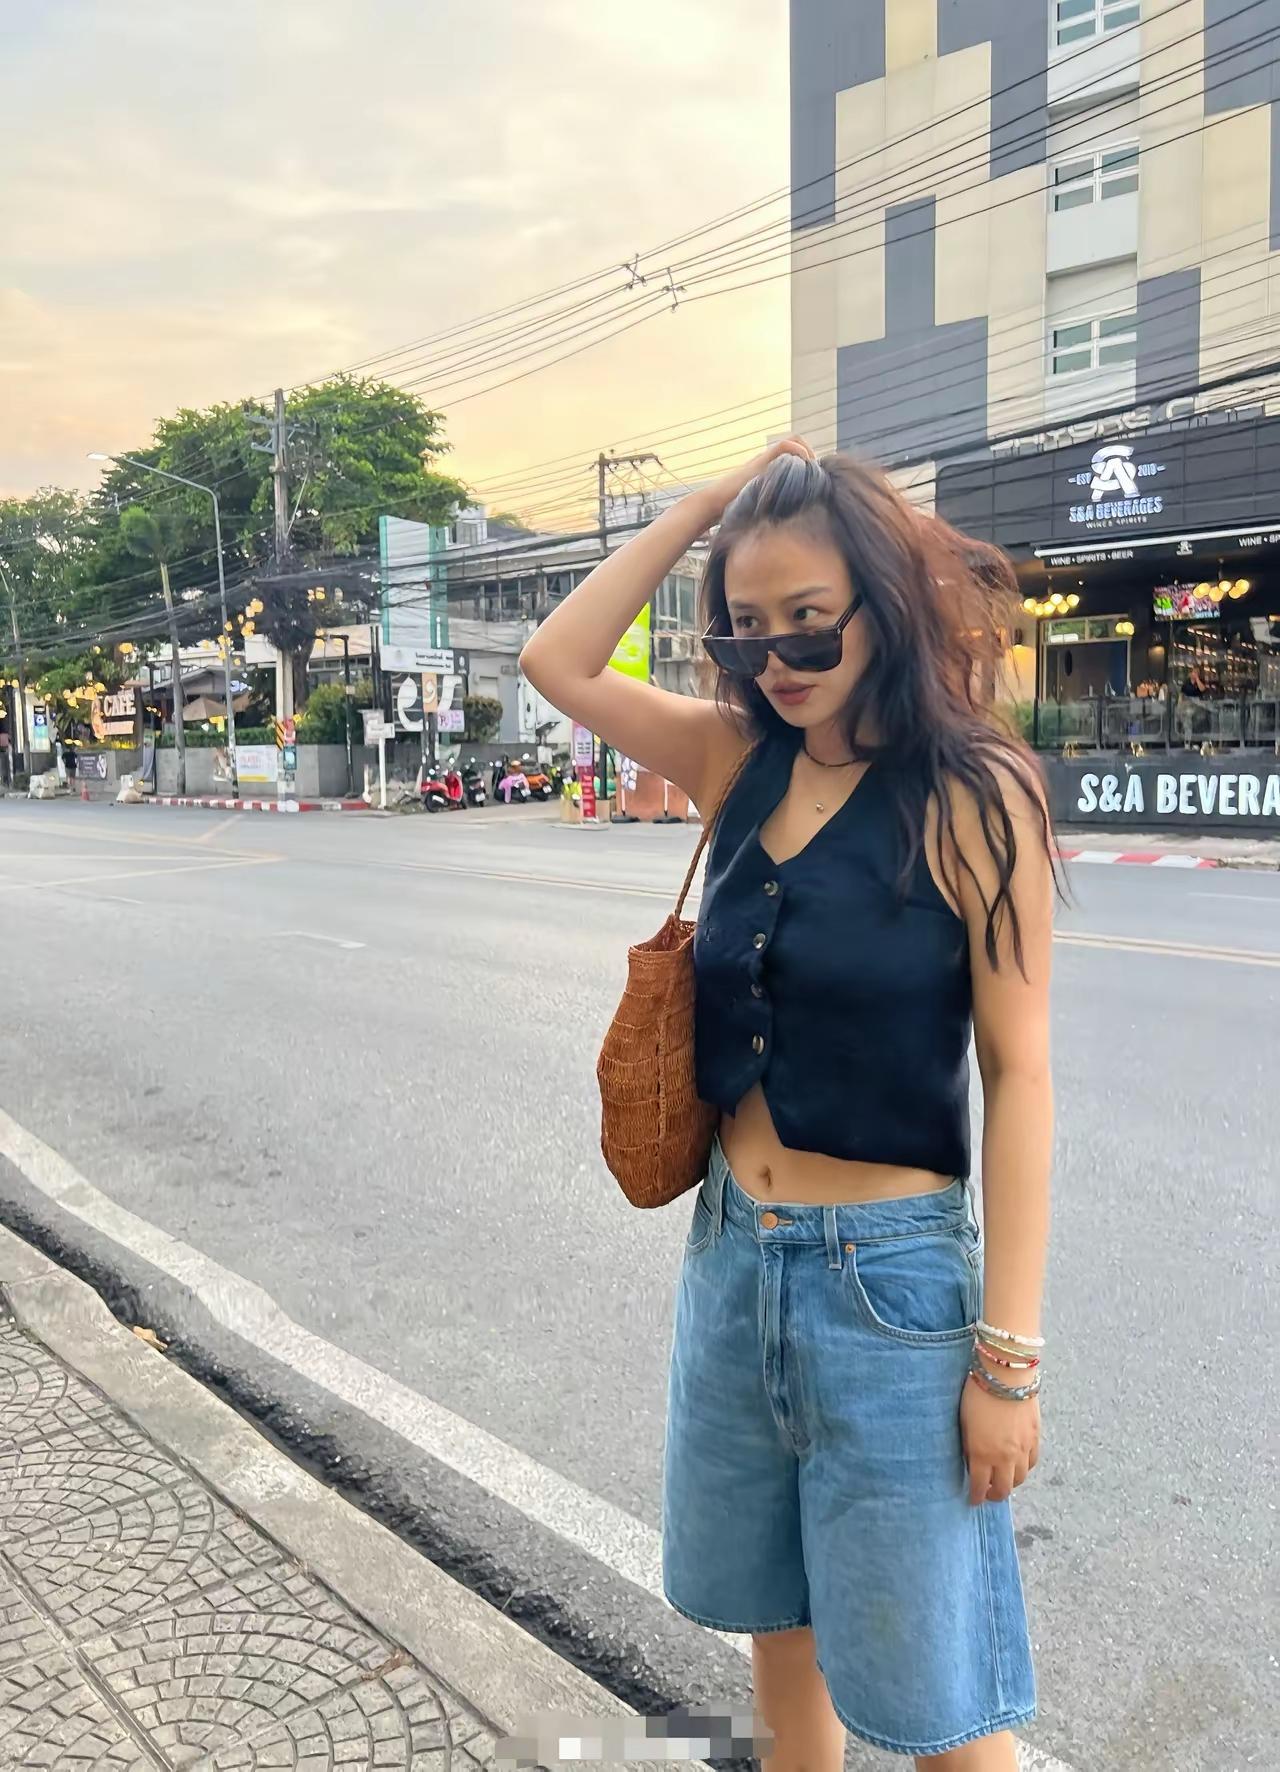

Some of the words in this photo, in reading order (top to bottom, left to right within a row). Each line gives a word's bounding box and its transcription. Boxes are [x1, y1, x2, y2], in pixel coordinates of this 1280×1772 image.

[1069, 504, 1094, 523] S&A
[1096, 496, 1163, 520] BEVERAGES
[1238, 535, 1262, 547] WINE
[1077, 773, 1145, 813] S&A
[1156, 774, 1280, 816] BEVERA
